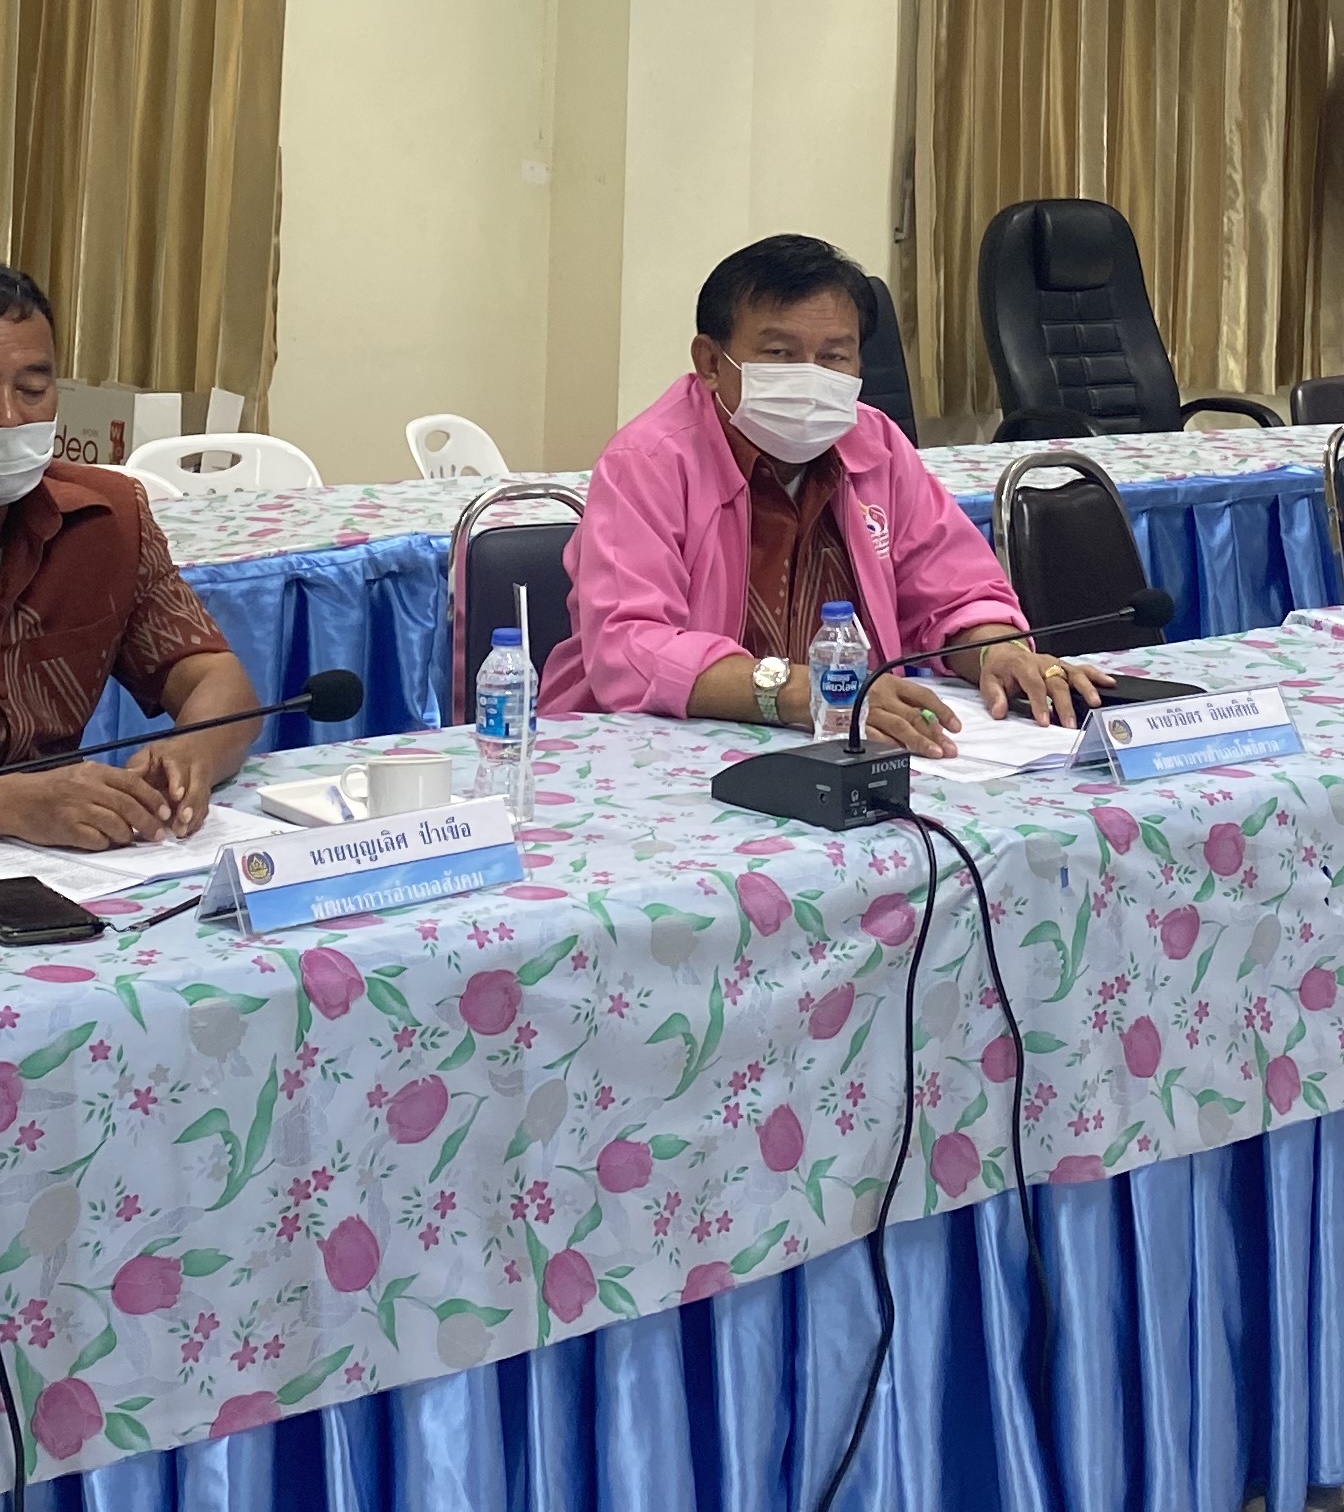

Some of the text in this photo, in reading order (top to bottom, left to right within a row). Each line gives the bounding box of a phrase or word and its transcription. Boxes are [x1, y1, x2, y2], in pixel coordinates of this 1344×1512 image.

[1146, 707, 1203, 731] นายวิจิตร
[309, 829, 409, 866] นายบุญเลิศ
[310, 870, 485, 920] พัฒนาการอำเภอสังคม
